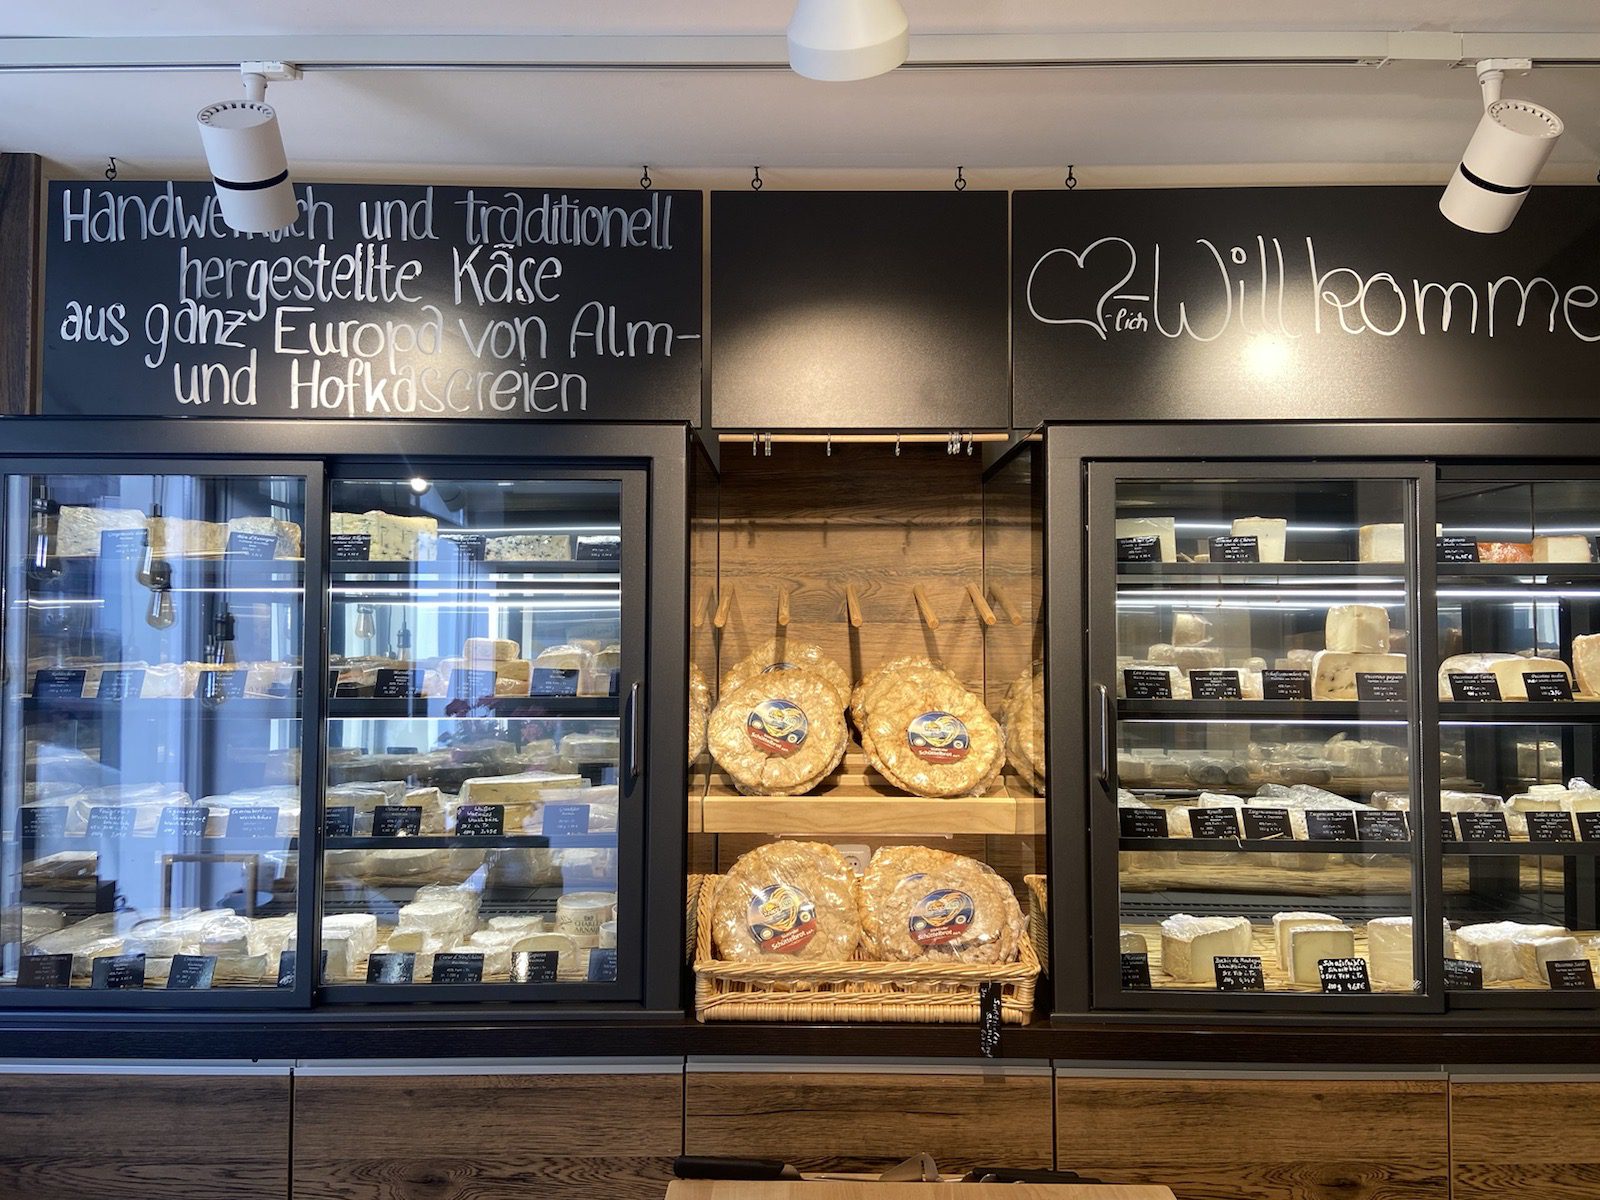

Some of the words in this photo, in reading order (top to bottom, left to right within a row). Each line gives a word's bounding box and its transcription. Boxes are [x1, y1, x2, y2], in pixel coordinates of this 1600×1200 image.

[360, 186, 439, 242] und
[454, 190, 674, 250] traditionell
[178, 243, 422, 323] hergestellte
[452, 243, 562, 306] Käse
[60, 300, 130, 346] aus
[144, 298, 247, 369] ganz
[274, 304, 444, 376] Europa
[458, 315, 548, 359] von
[569, 301, 701, 358] Alm-
[173, 348, 257, 405] und
